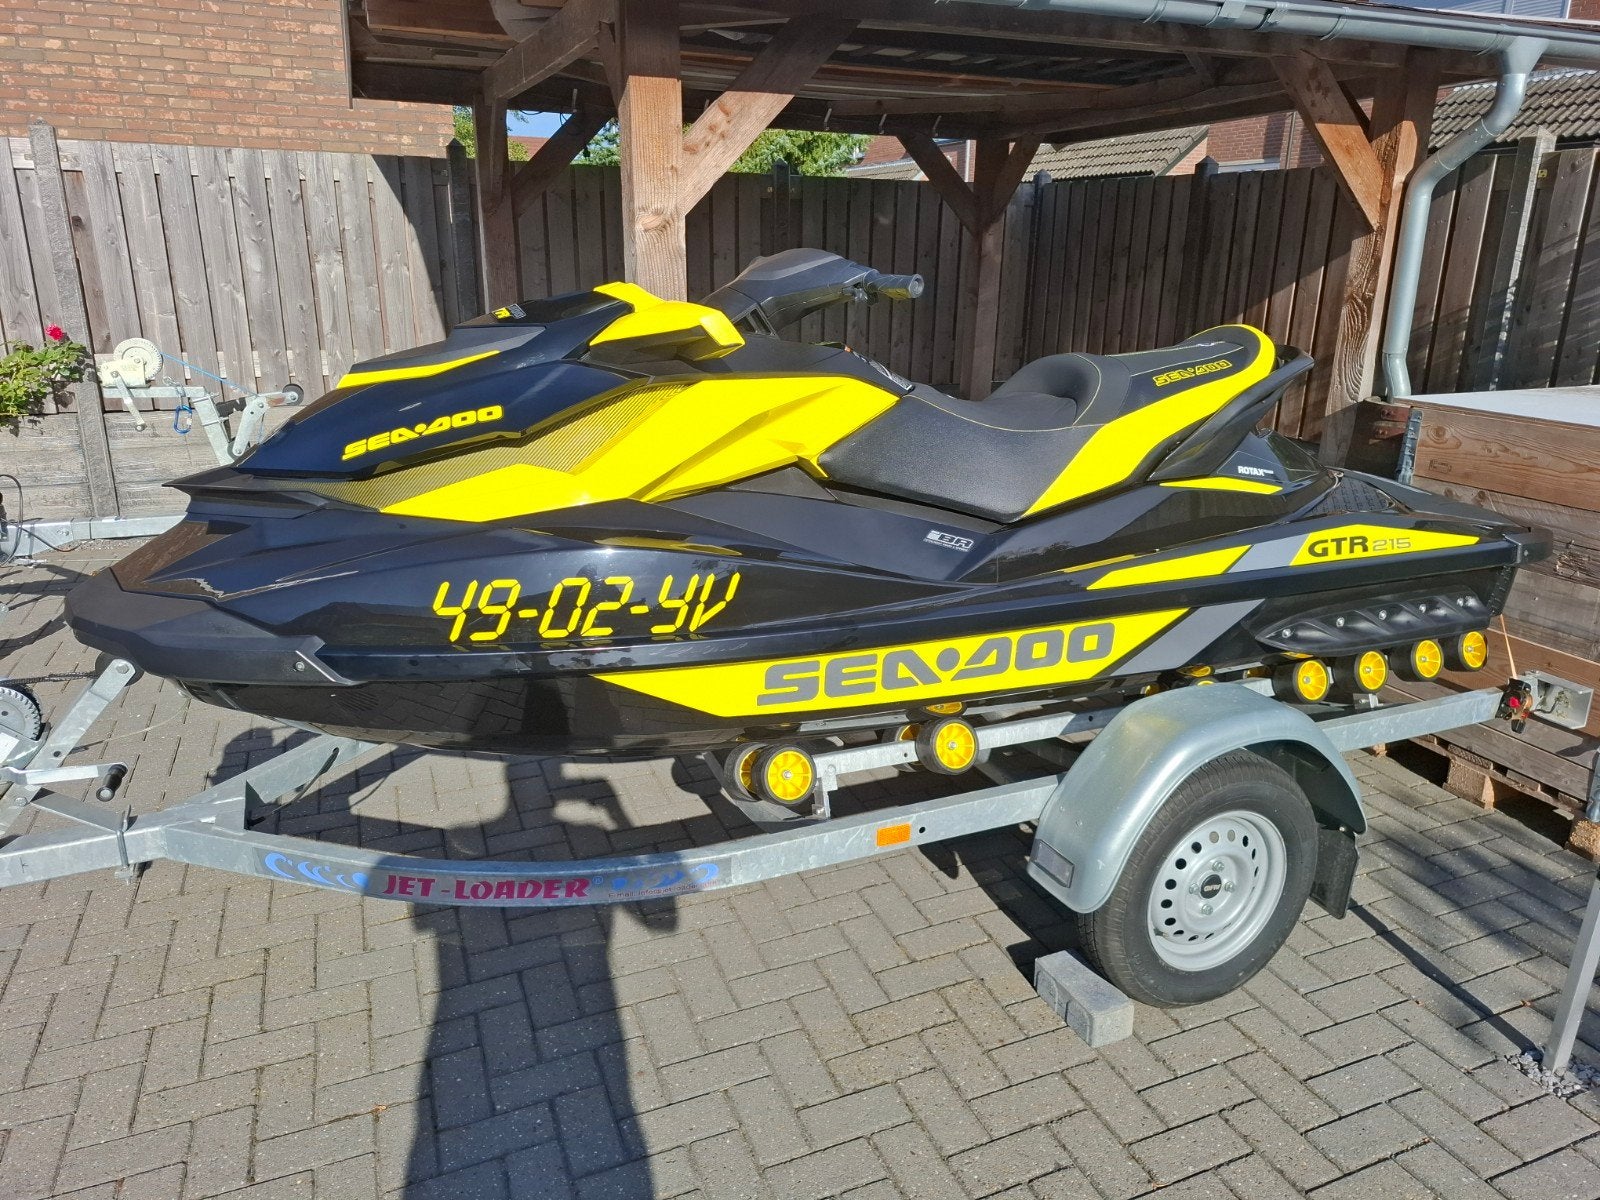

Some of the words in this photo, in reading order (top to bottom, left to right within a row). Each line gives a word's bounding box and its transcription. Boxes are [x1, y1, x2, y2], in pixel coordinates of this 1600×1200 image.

[1237, 465, 1265, 477] ROTAX
[1307, 535, 1369, 558] GTR
[1372, 537, 1412, 552] 215
